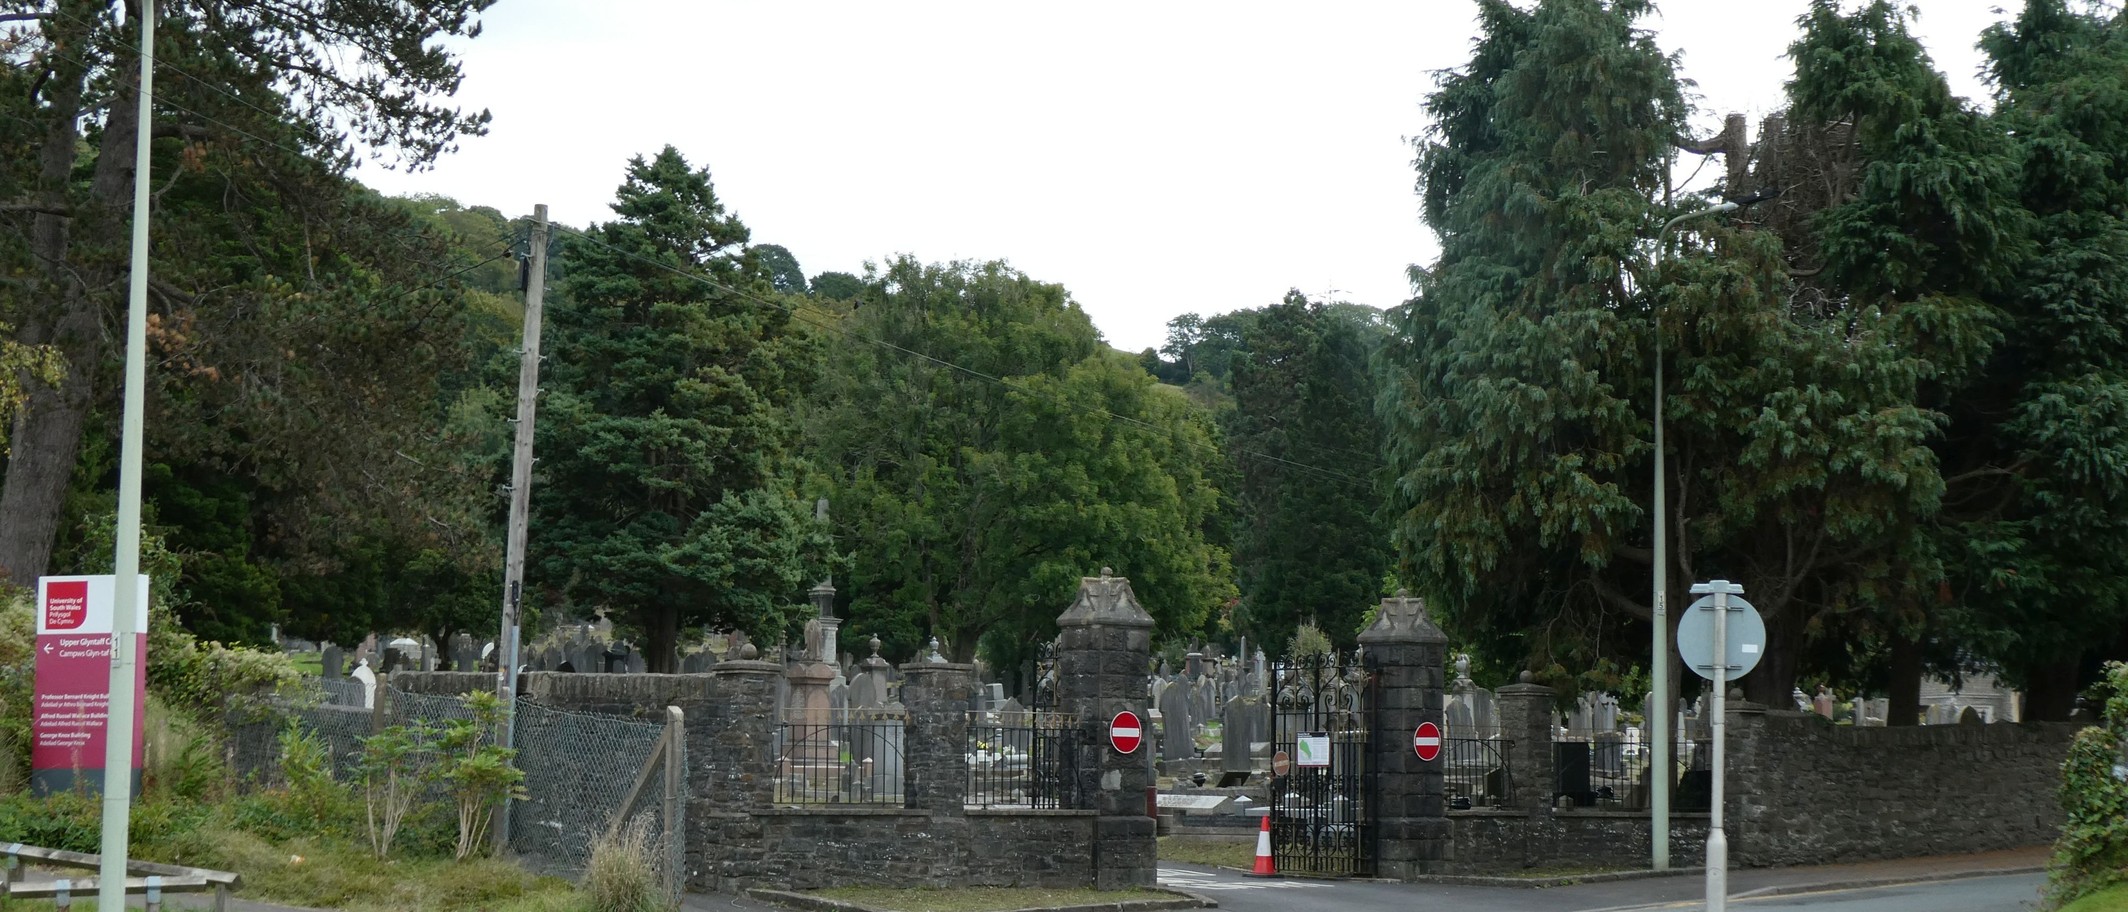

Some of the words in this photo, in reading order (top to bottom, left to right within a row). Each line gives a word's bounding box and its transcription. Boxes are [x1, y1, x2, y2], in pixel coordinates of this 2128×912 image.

[60, 638, 79, 647] Upper
[80, 638, 104, 646] Glyntaff
[60, 650, 85, 658] Campws
[86, 649, 109, 658] Glyn-taf
